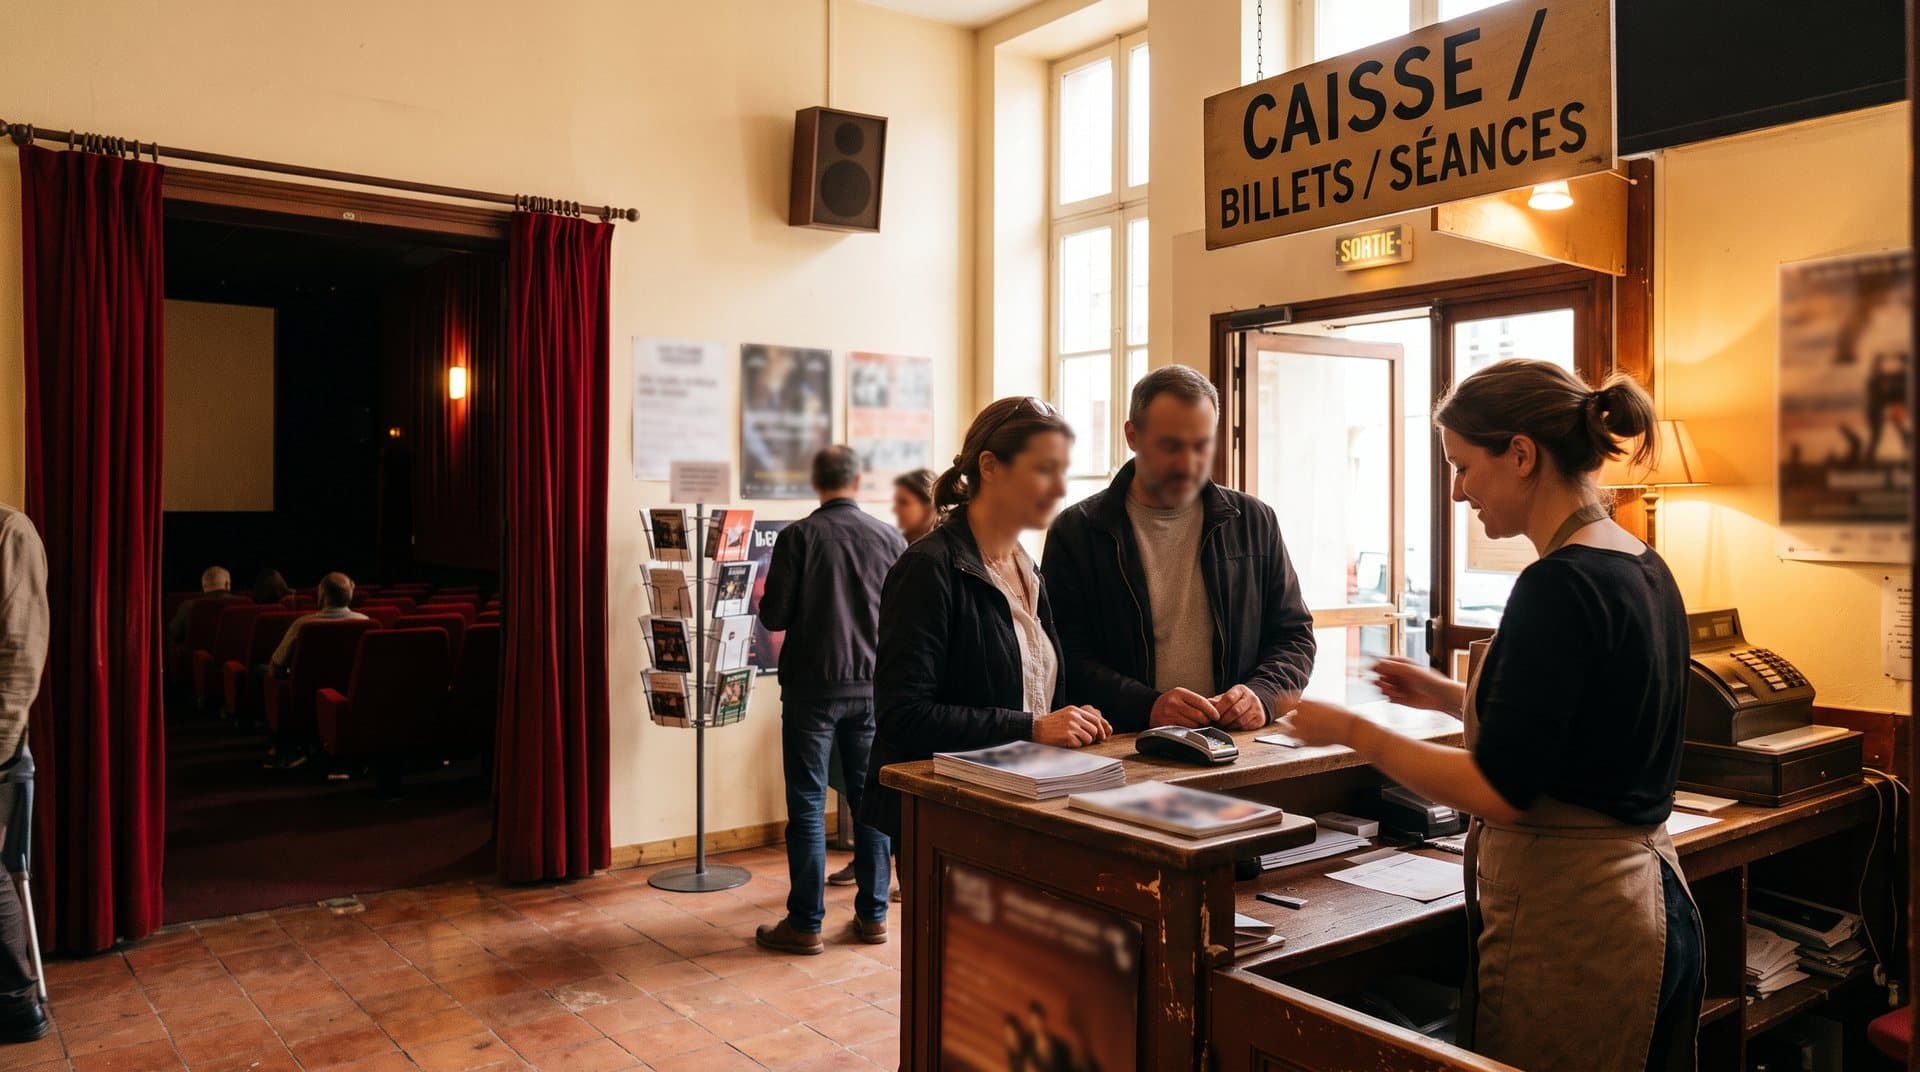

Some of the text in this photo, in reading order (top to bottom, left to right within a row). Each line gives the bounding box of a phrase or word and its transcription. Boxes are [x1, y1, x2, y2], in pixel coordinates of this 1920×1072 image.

[1243, 8, 1548, 160] CAISSE /
[1221, 158, 1355, 229] BILLETS
[1389, 101, 1588, 192] SÉANCES
[1341, 231, 1395, 262] SORTIE
